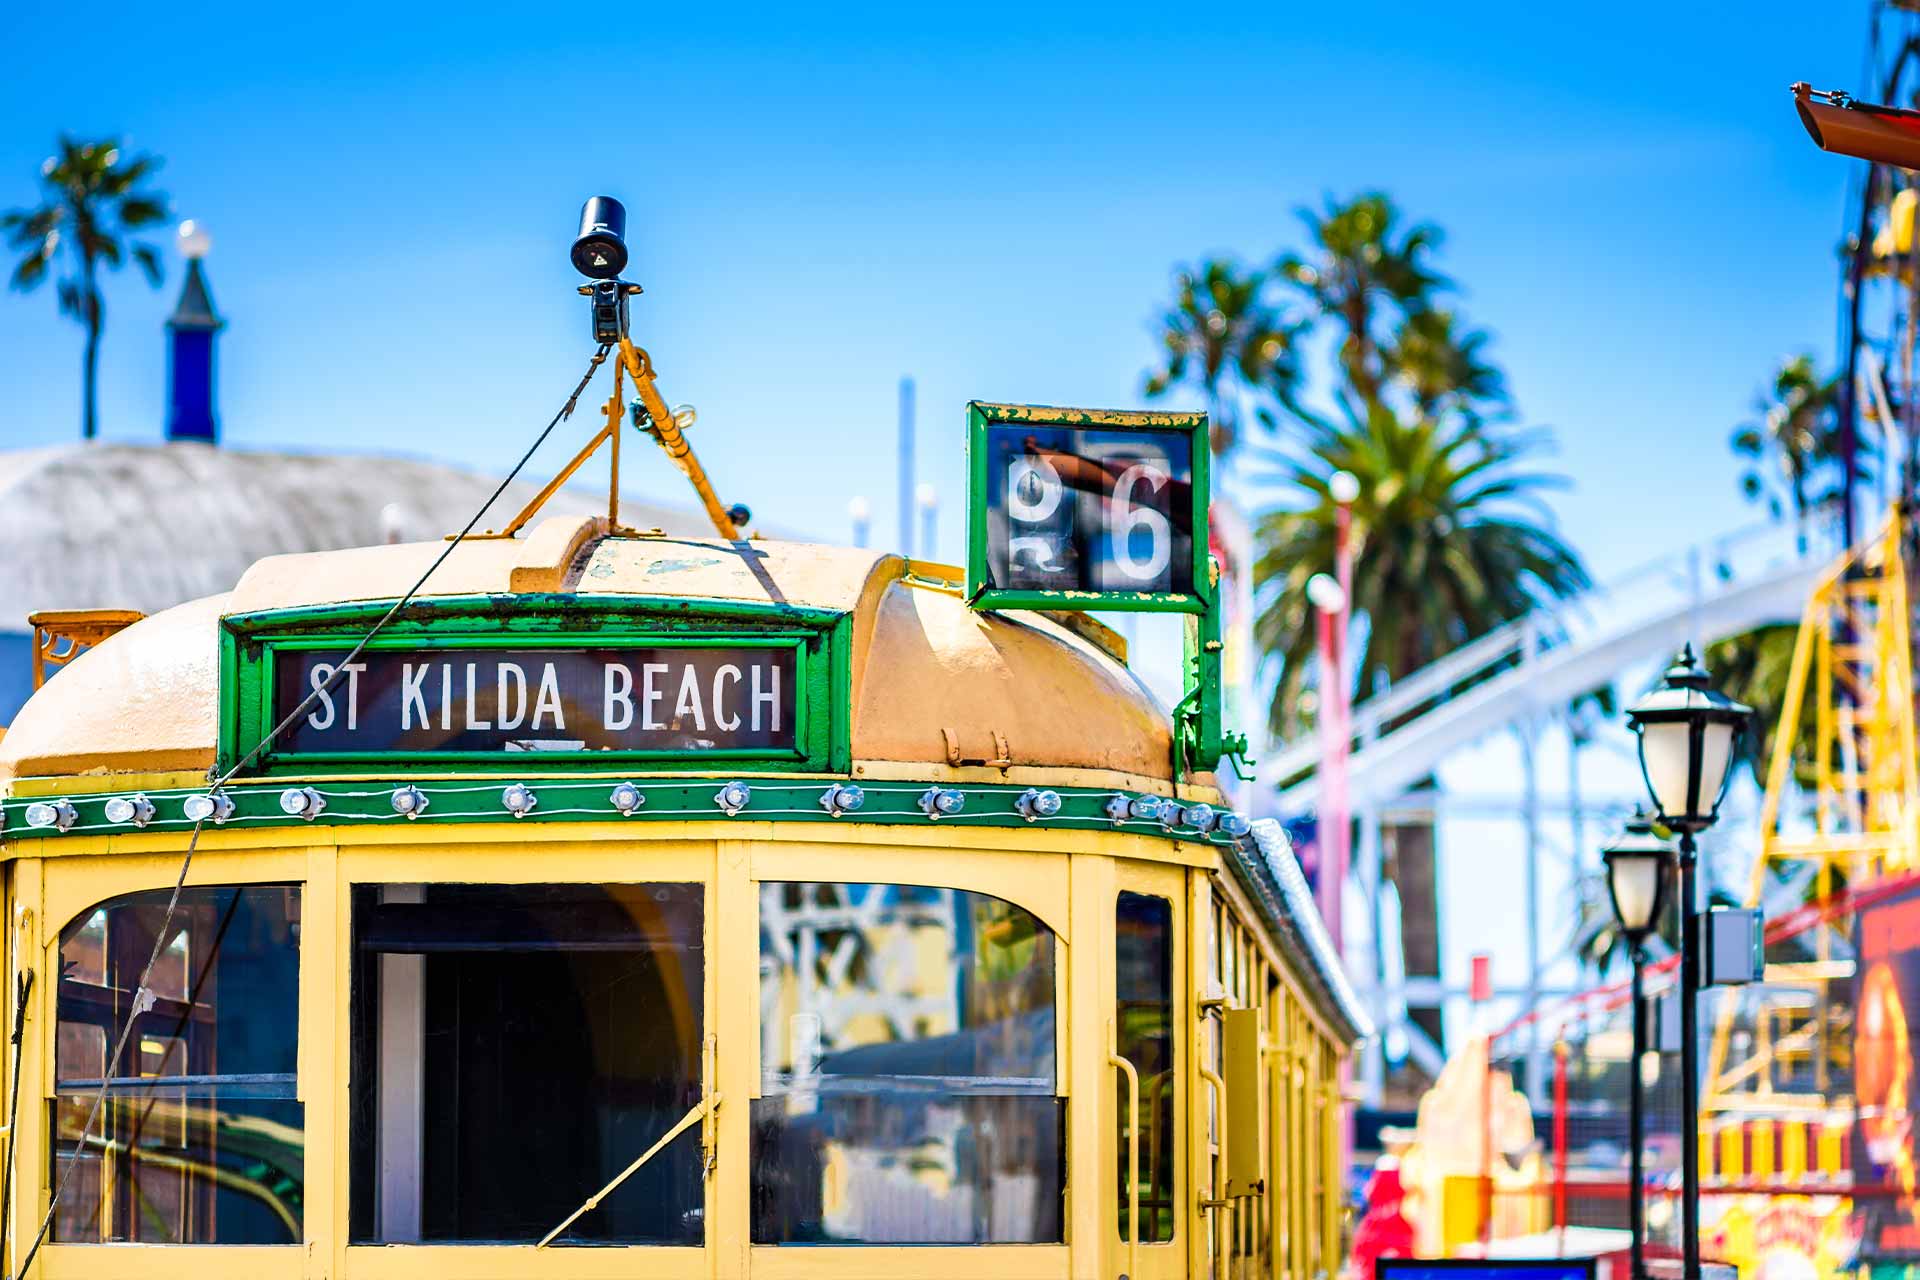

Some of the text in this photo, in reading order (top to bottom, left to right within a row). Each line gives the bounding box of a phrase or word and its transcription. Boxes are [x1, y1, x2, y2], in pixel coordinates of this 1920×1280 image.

[1111, 464, 1171, 580] 6
[308, 662, 780, 732] ST KILDA BEACH
